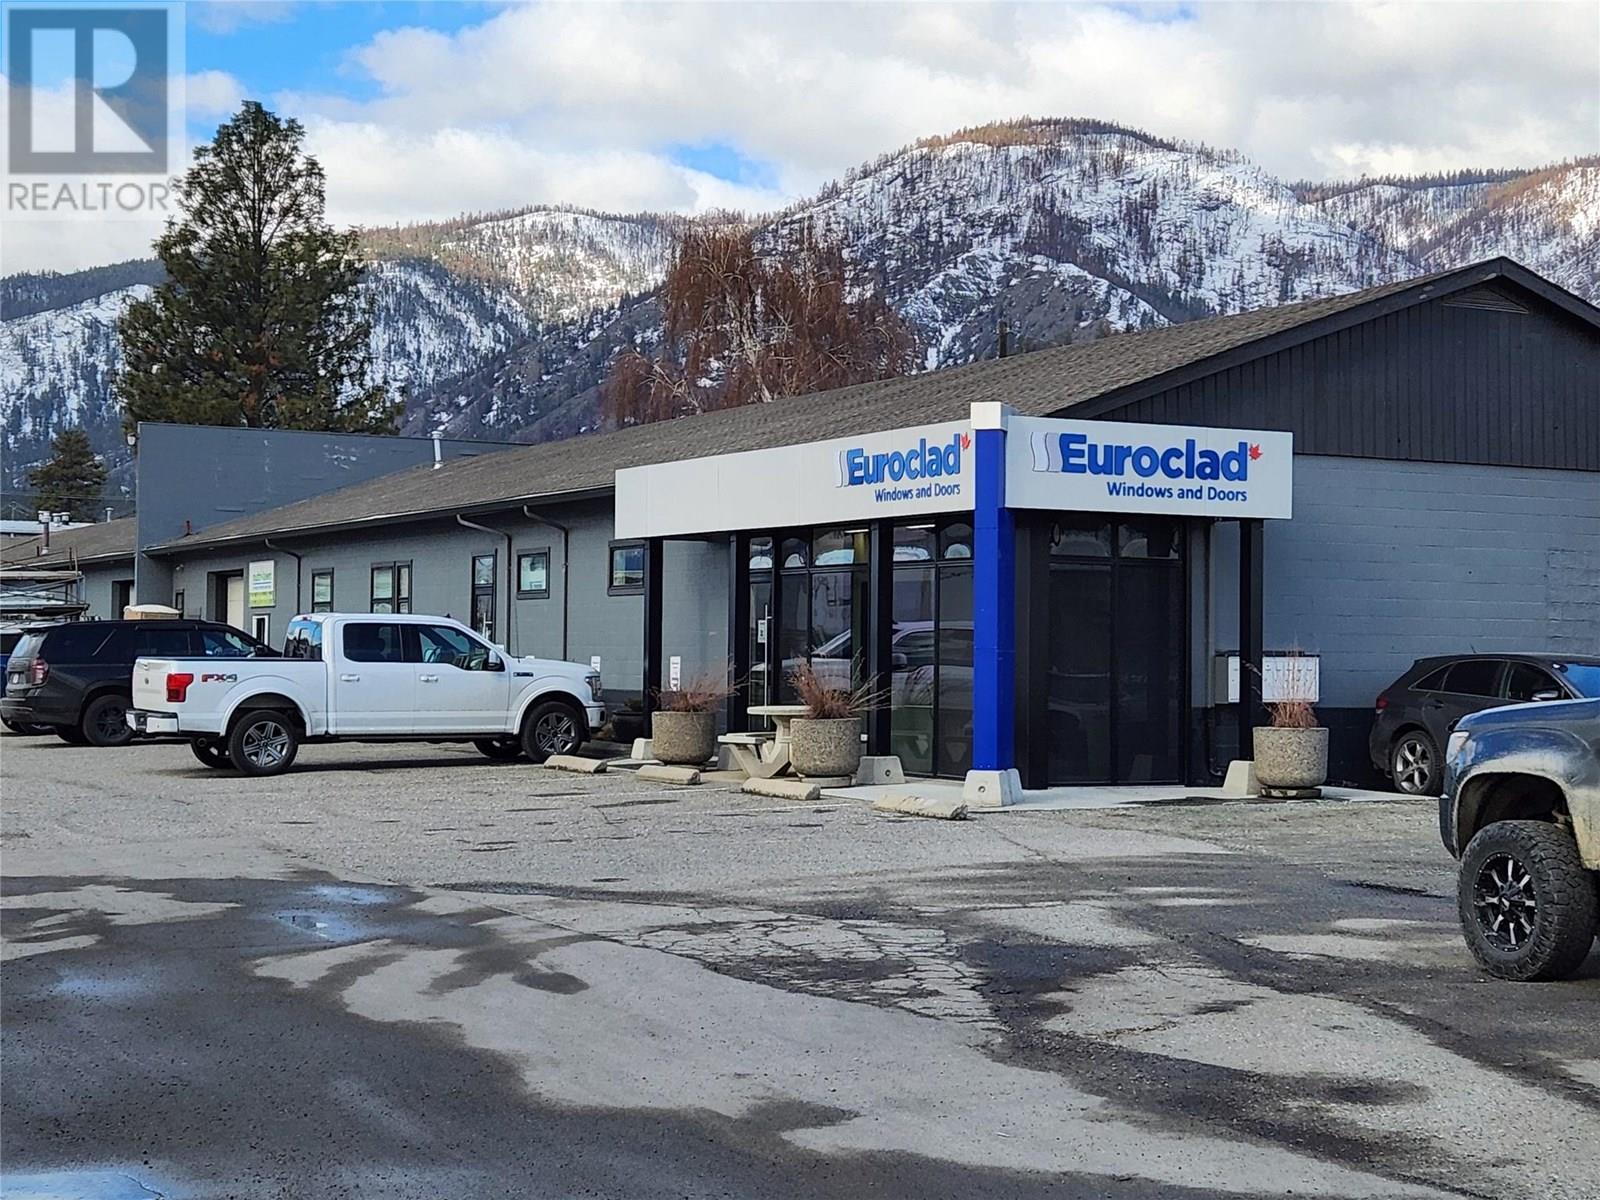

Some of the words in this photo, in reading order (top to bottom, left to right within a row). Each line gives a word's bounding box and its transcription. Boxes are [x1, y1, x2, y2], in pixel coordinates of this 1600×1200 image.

[846, 433, 961, 486] Euroclad
[1058, 433, 1249, 482] Euroclad
[874, 487, 913, 503] Windows
[915, 483, 932, 499] and
[934, 482, 961, 497] Doors
[1106, 481, 1174, 498] Windows
[1177, 485, 1203, 500] and
[1207, 486, 1248, 502] Doors
[201, 673, 238, 683] FX4
